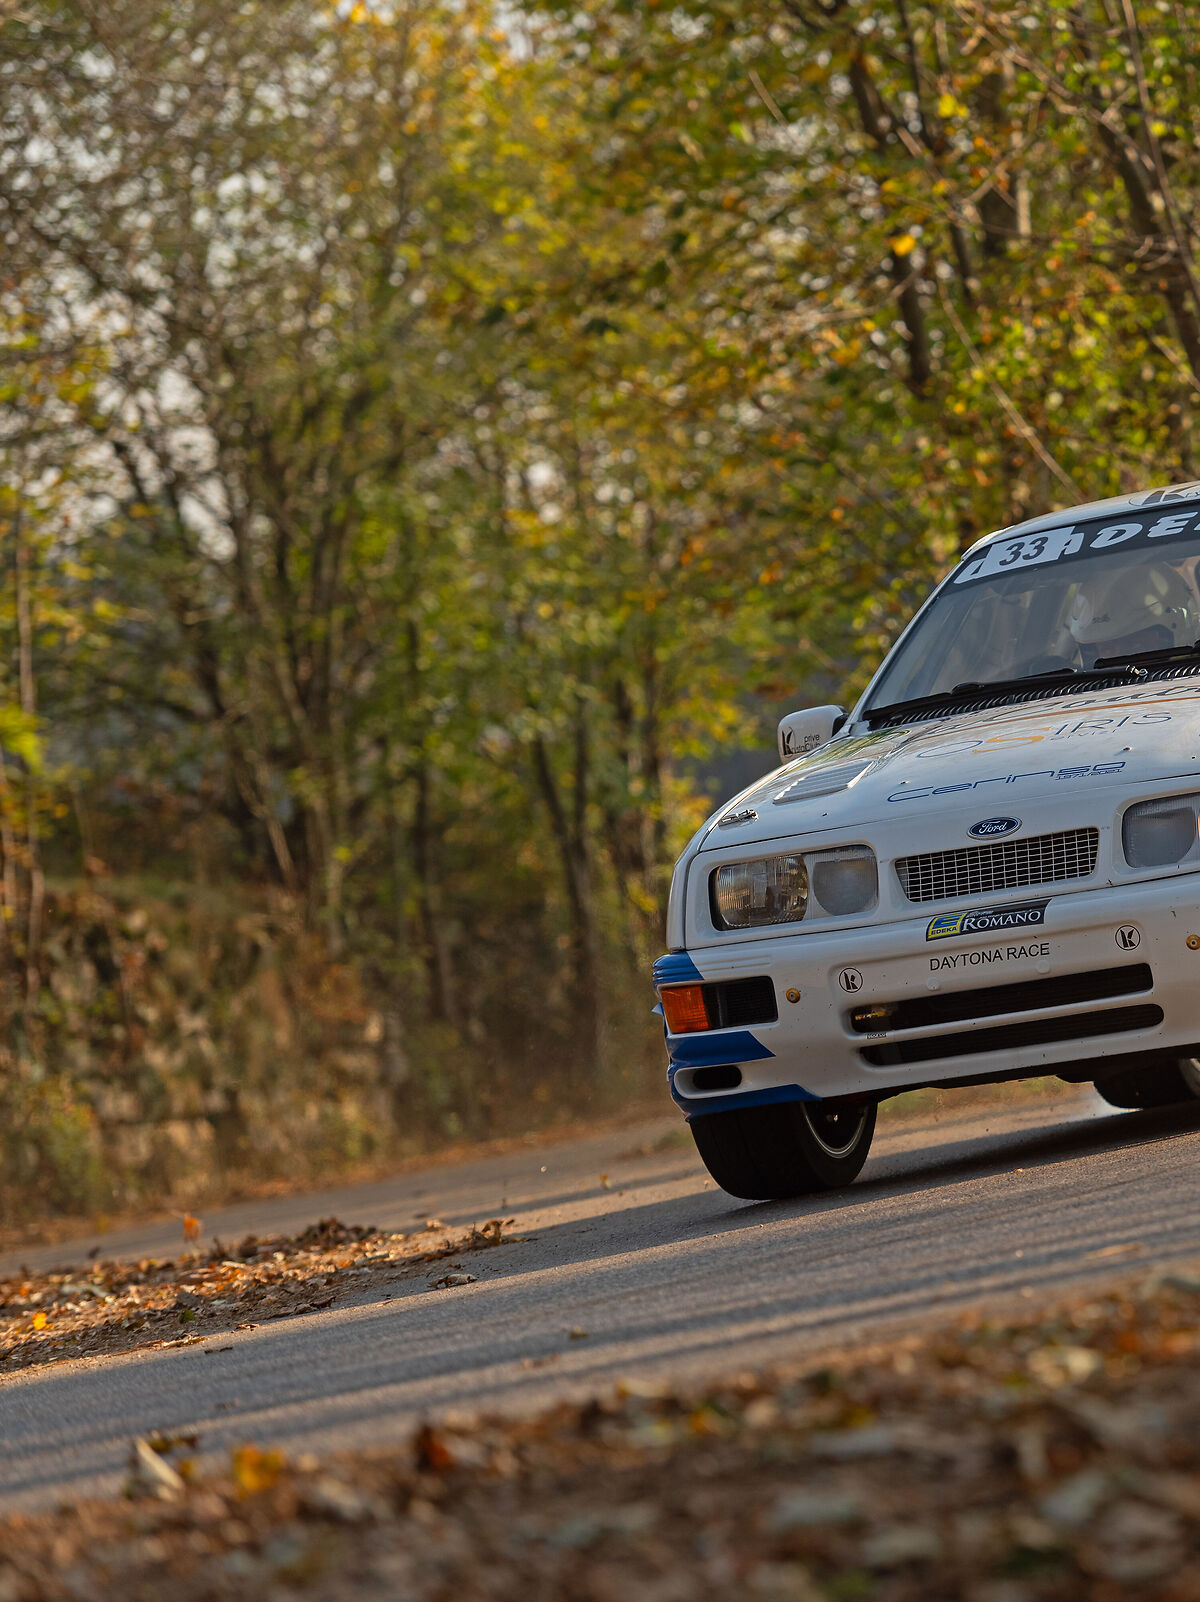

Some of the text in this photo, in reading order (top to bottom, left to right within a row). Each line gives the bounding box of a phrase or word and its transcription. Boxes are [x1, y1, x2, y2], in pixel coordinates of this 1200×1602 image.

[998, 536, 1049, 566] 33
[978, 821, 1008, 834] Ford
[930, 926, 958, 936] EDEKA
[930, 943, 1050, 971] DAYTONA RACE
